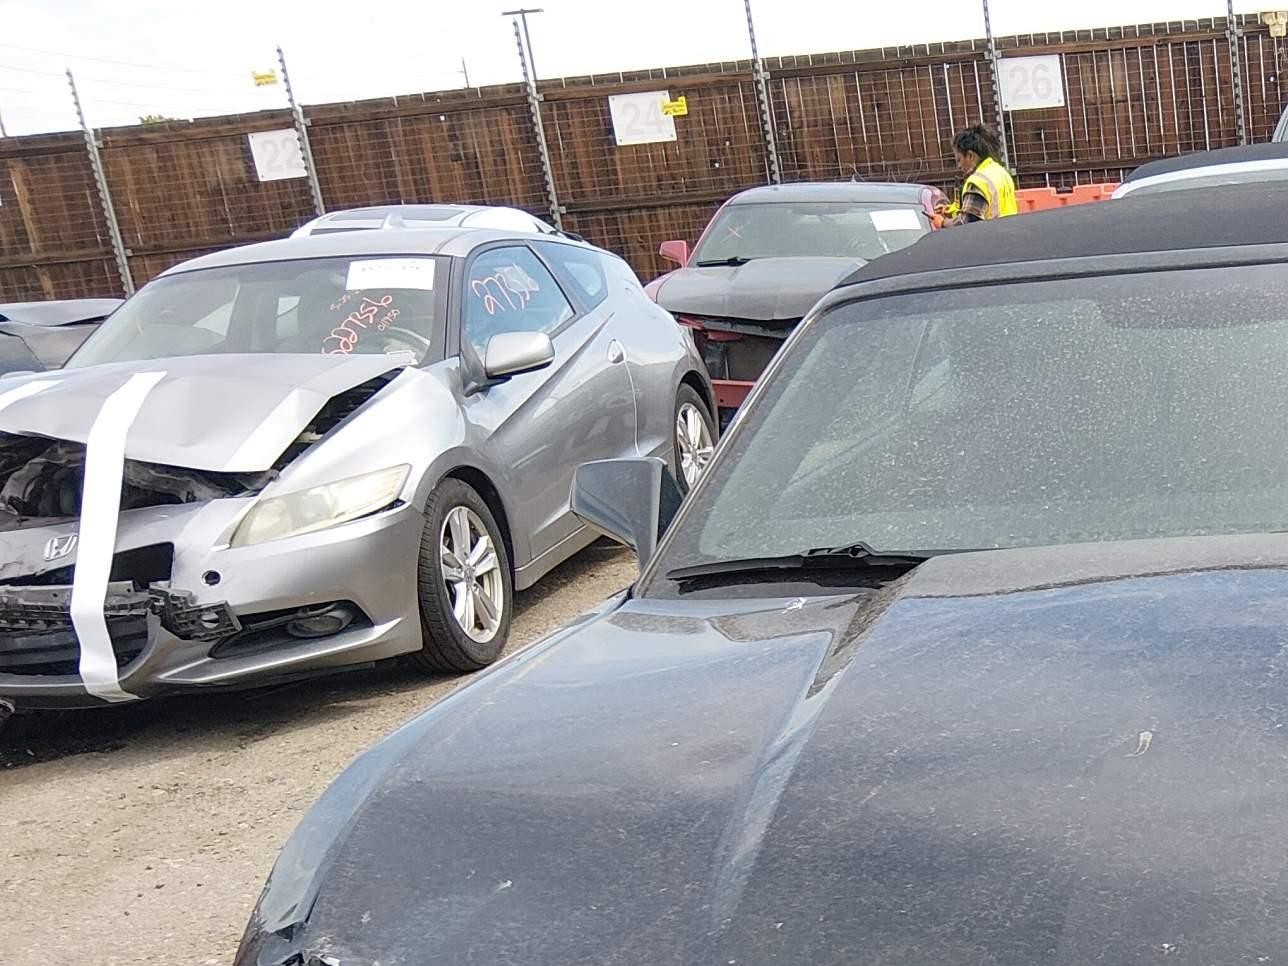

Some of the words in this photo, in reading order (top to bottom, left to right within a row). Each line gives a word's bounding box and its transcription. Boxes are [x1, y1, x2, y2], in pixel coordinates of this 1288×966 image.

[1008, 63, 1053, 101] 26
[621, 99, 666, 137] 24
[260, 137, 305, 172] 22
